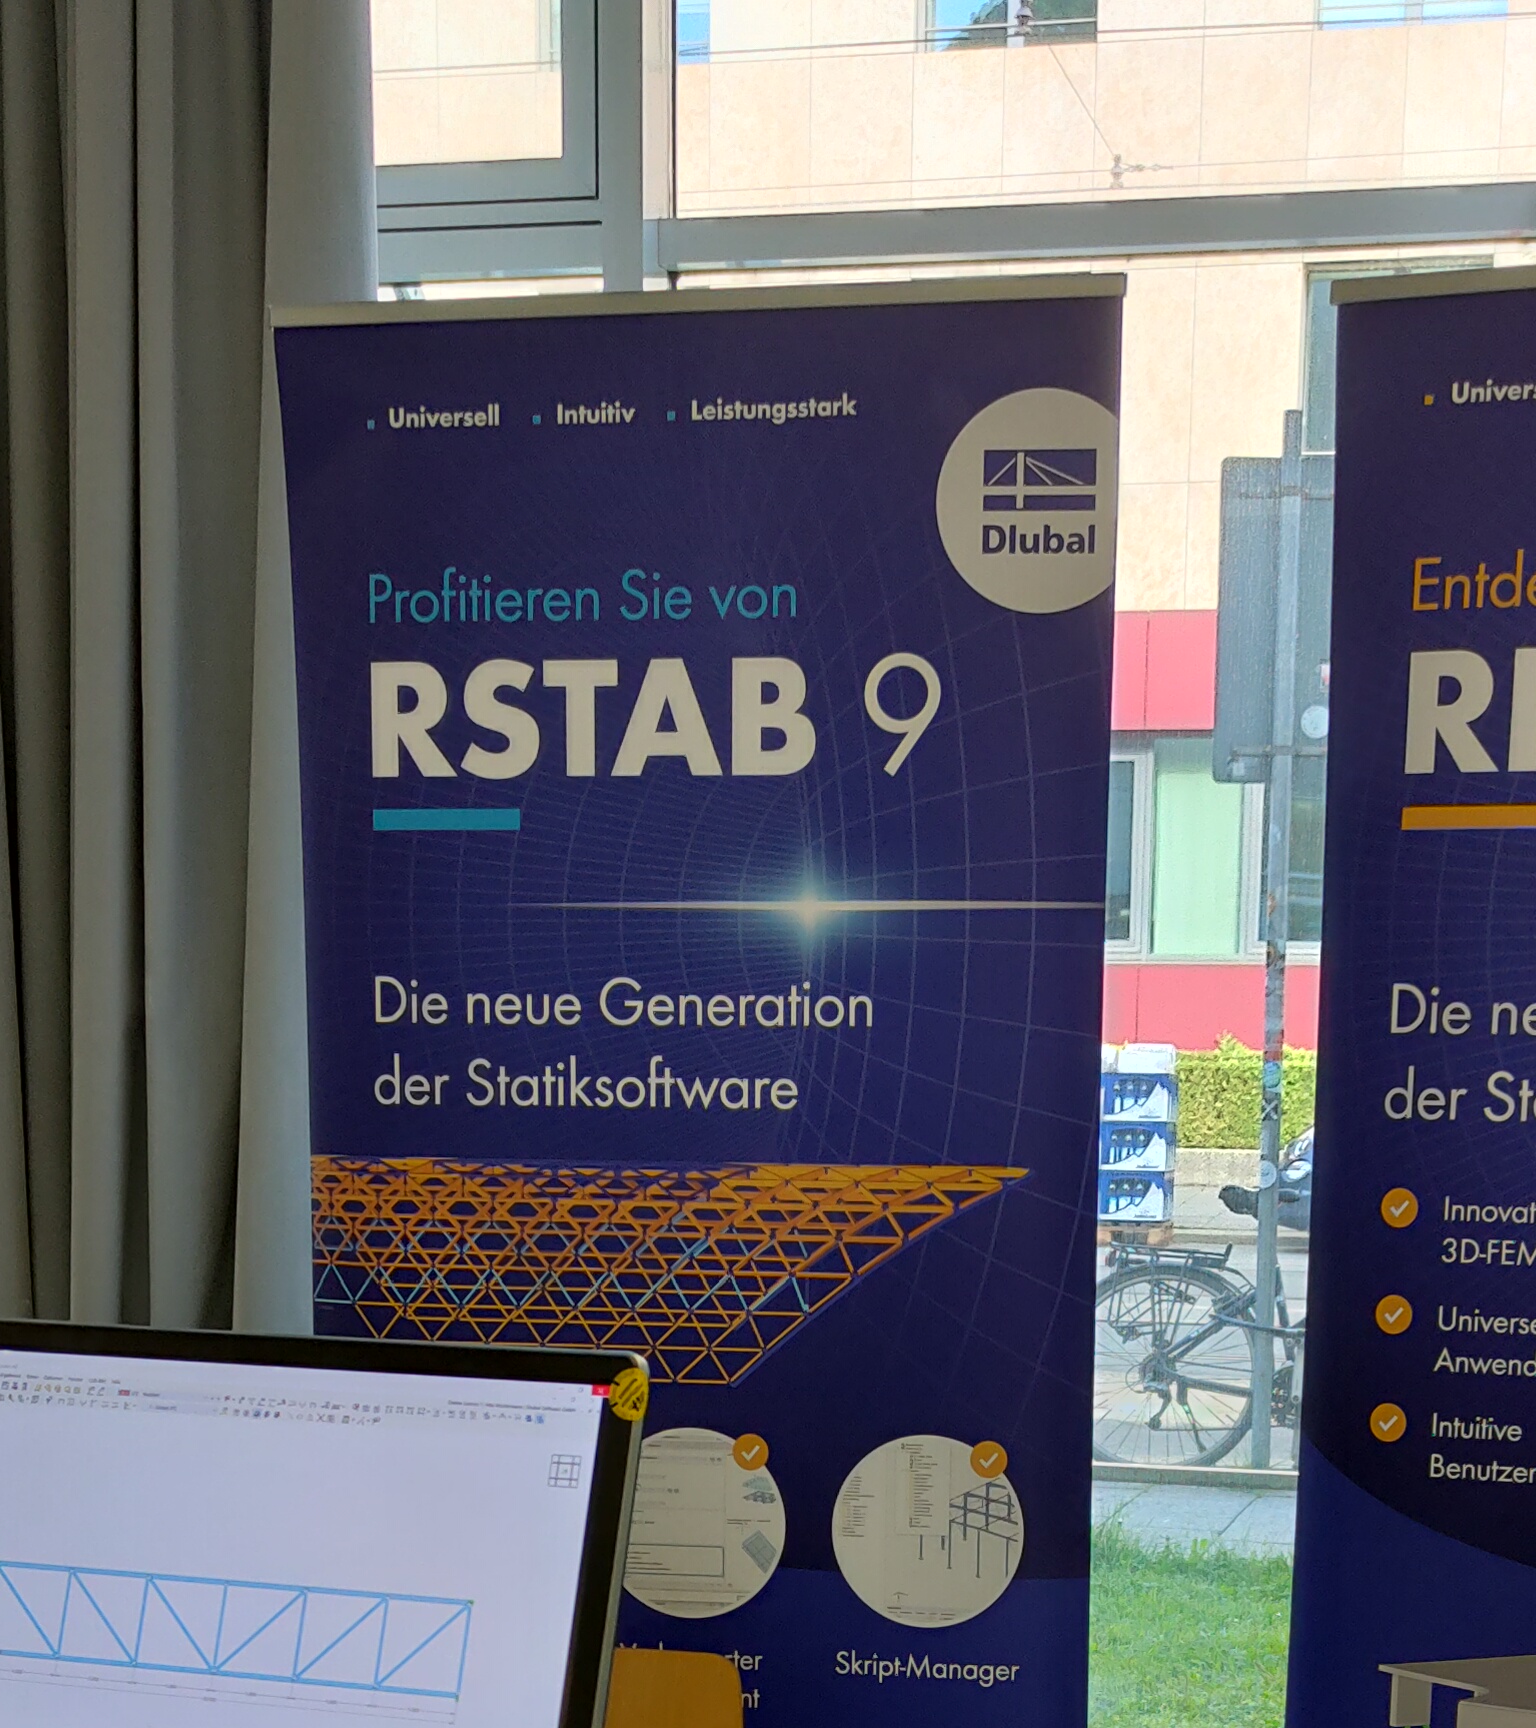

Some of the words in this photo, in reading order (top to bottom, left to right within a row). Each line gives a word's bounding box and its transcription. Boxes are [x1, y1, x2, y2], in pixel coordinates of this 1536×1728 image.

[389, 405, 500, 429] Universell
[557, 402, 636, 426] Intuitiv
[691, 394, 857, 425] Leistungsstark
[982, 524, 1095, 556] Dlubal
[368, 569, 601, 624] Profitieren
[621, 569, 690, 621] Sie
[709, 579, 798, 620] von
[370, 658, 816, 779] RSTAB
[864, 652, 941, 778] 9
[374, 976, 449, 1025] Die
[466, 986, 581, 1025] neue
[600, 977, 874, 1028] Generation
[1390, 984, 1472, 1035] Die
[373, 1054, 450, 1107] der
[465, 1056, 798, 1111] Statiksoftware
[1384, 1067, 1465, 1121] der
[1431, 1413, 1523, 1442] Intuitive
[835, 1651, 1019, 1687] Skript-Manager
